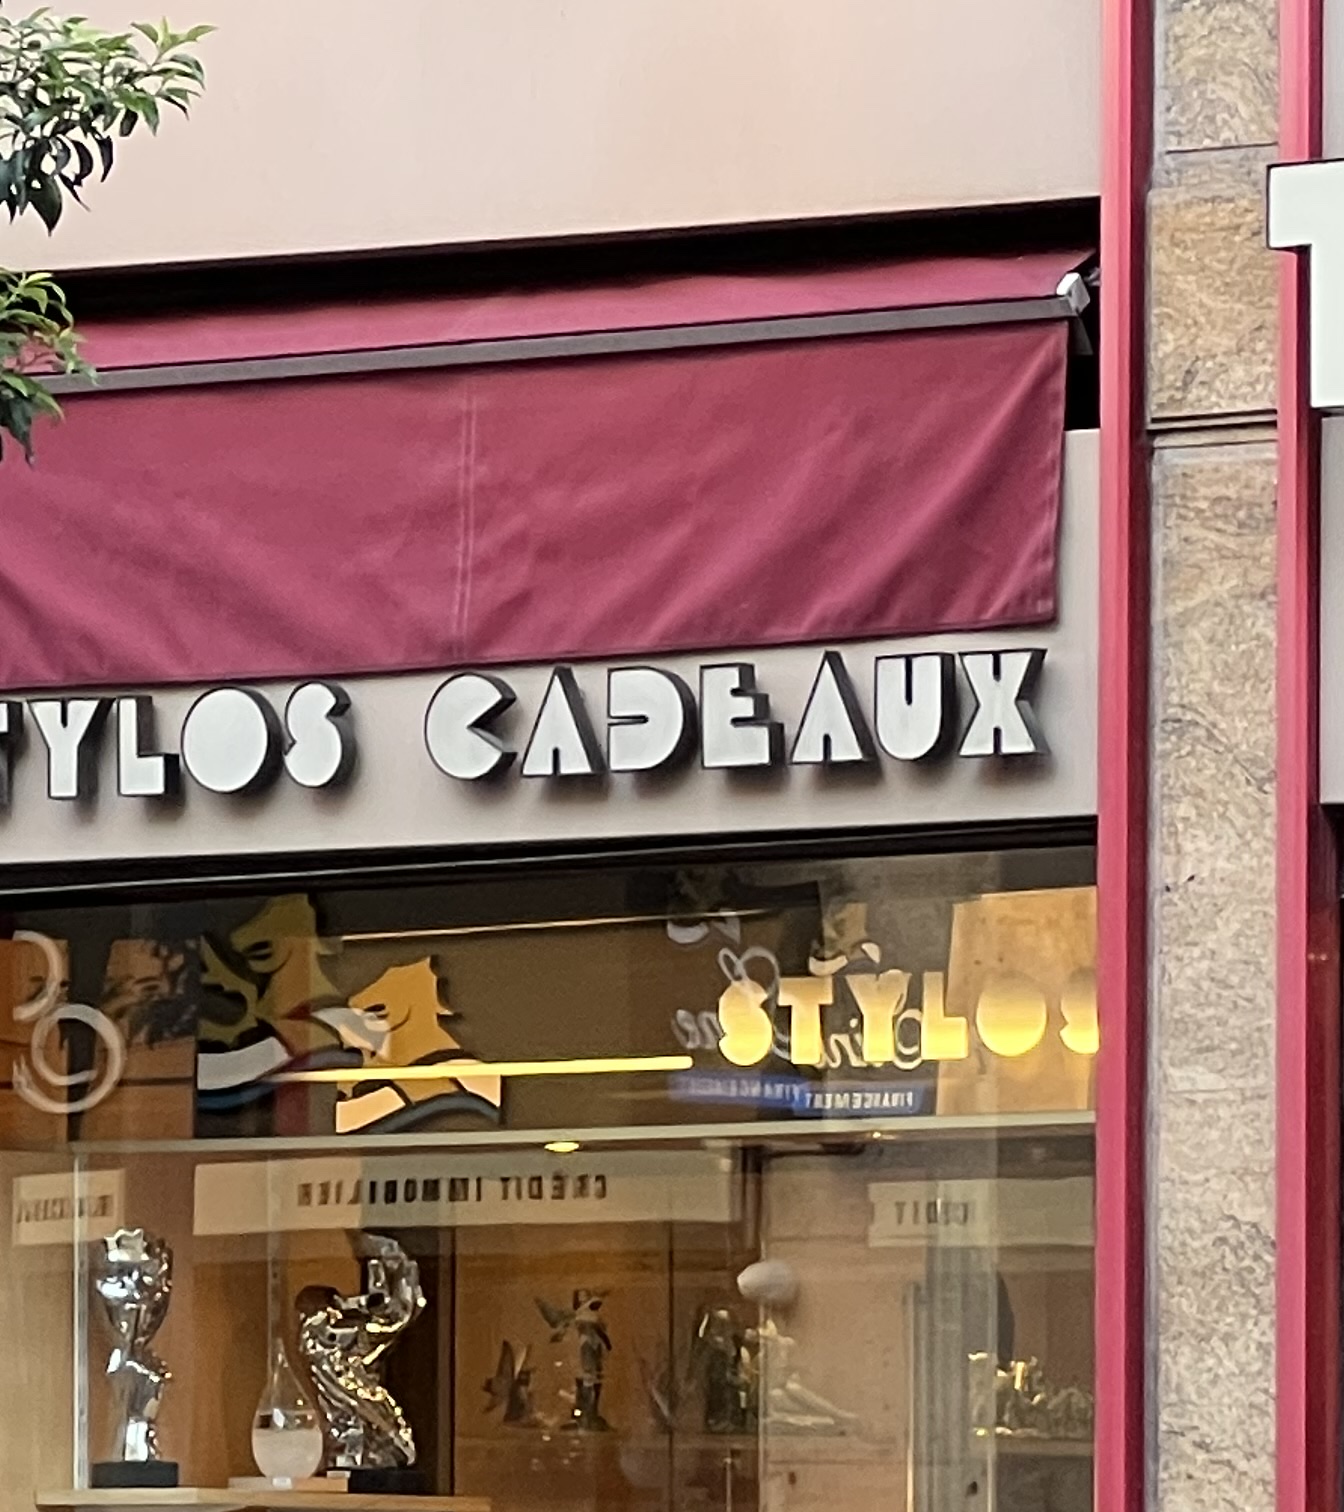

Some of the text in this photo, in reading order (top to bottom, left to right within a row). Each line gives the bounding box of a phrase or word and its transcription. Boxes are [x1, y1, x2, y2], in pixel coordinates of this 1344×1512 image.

[0, 648, 1047, 800] YLOS CADEAUX
[718, 970, 1099, 1067] STYLOS
